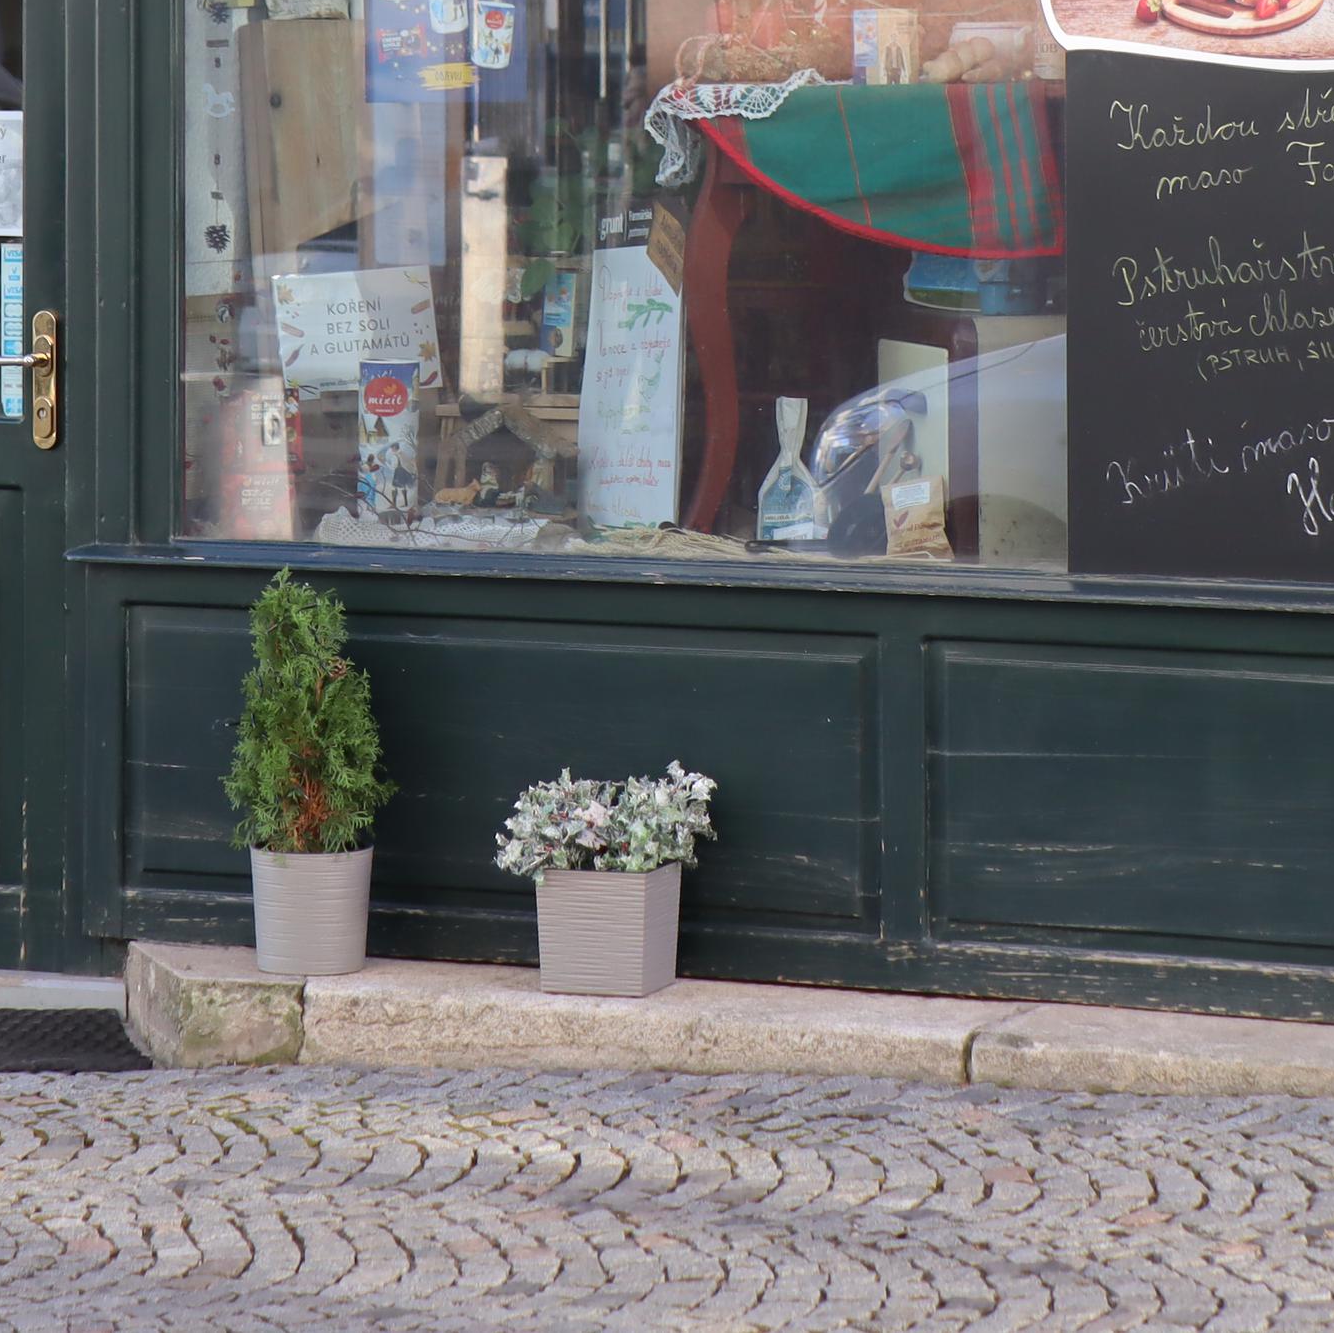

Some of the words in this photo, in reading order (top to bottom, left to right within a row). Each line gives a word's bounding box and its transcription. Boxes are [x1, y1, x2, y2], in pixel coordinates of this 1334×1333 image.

[1110, 100, 1259, 150] Každou
[1156, 165, 1254, 200] maso
[327, 296, 381, 316] KOŘENÍ
[327, 321, 354, 335] BEZ
[359, 319, 390, 332] SOLI
[1135, 298, 1242, 352] čerstvá
[310, 345, 319, 356] A
[324, 335, 410, 355] GLUTAMÁTŮ
[367, 394, 403, 407] mixit
